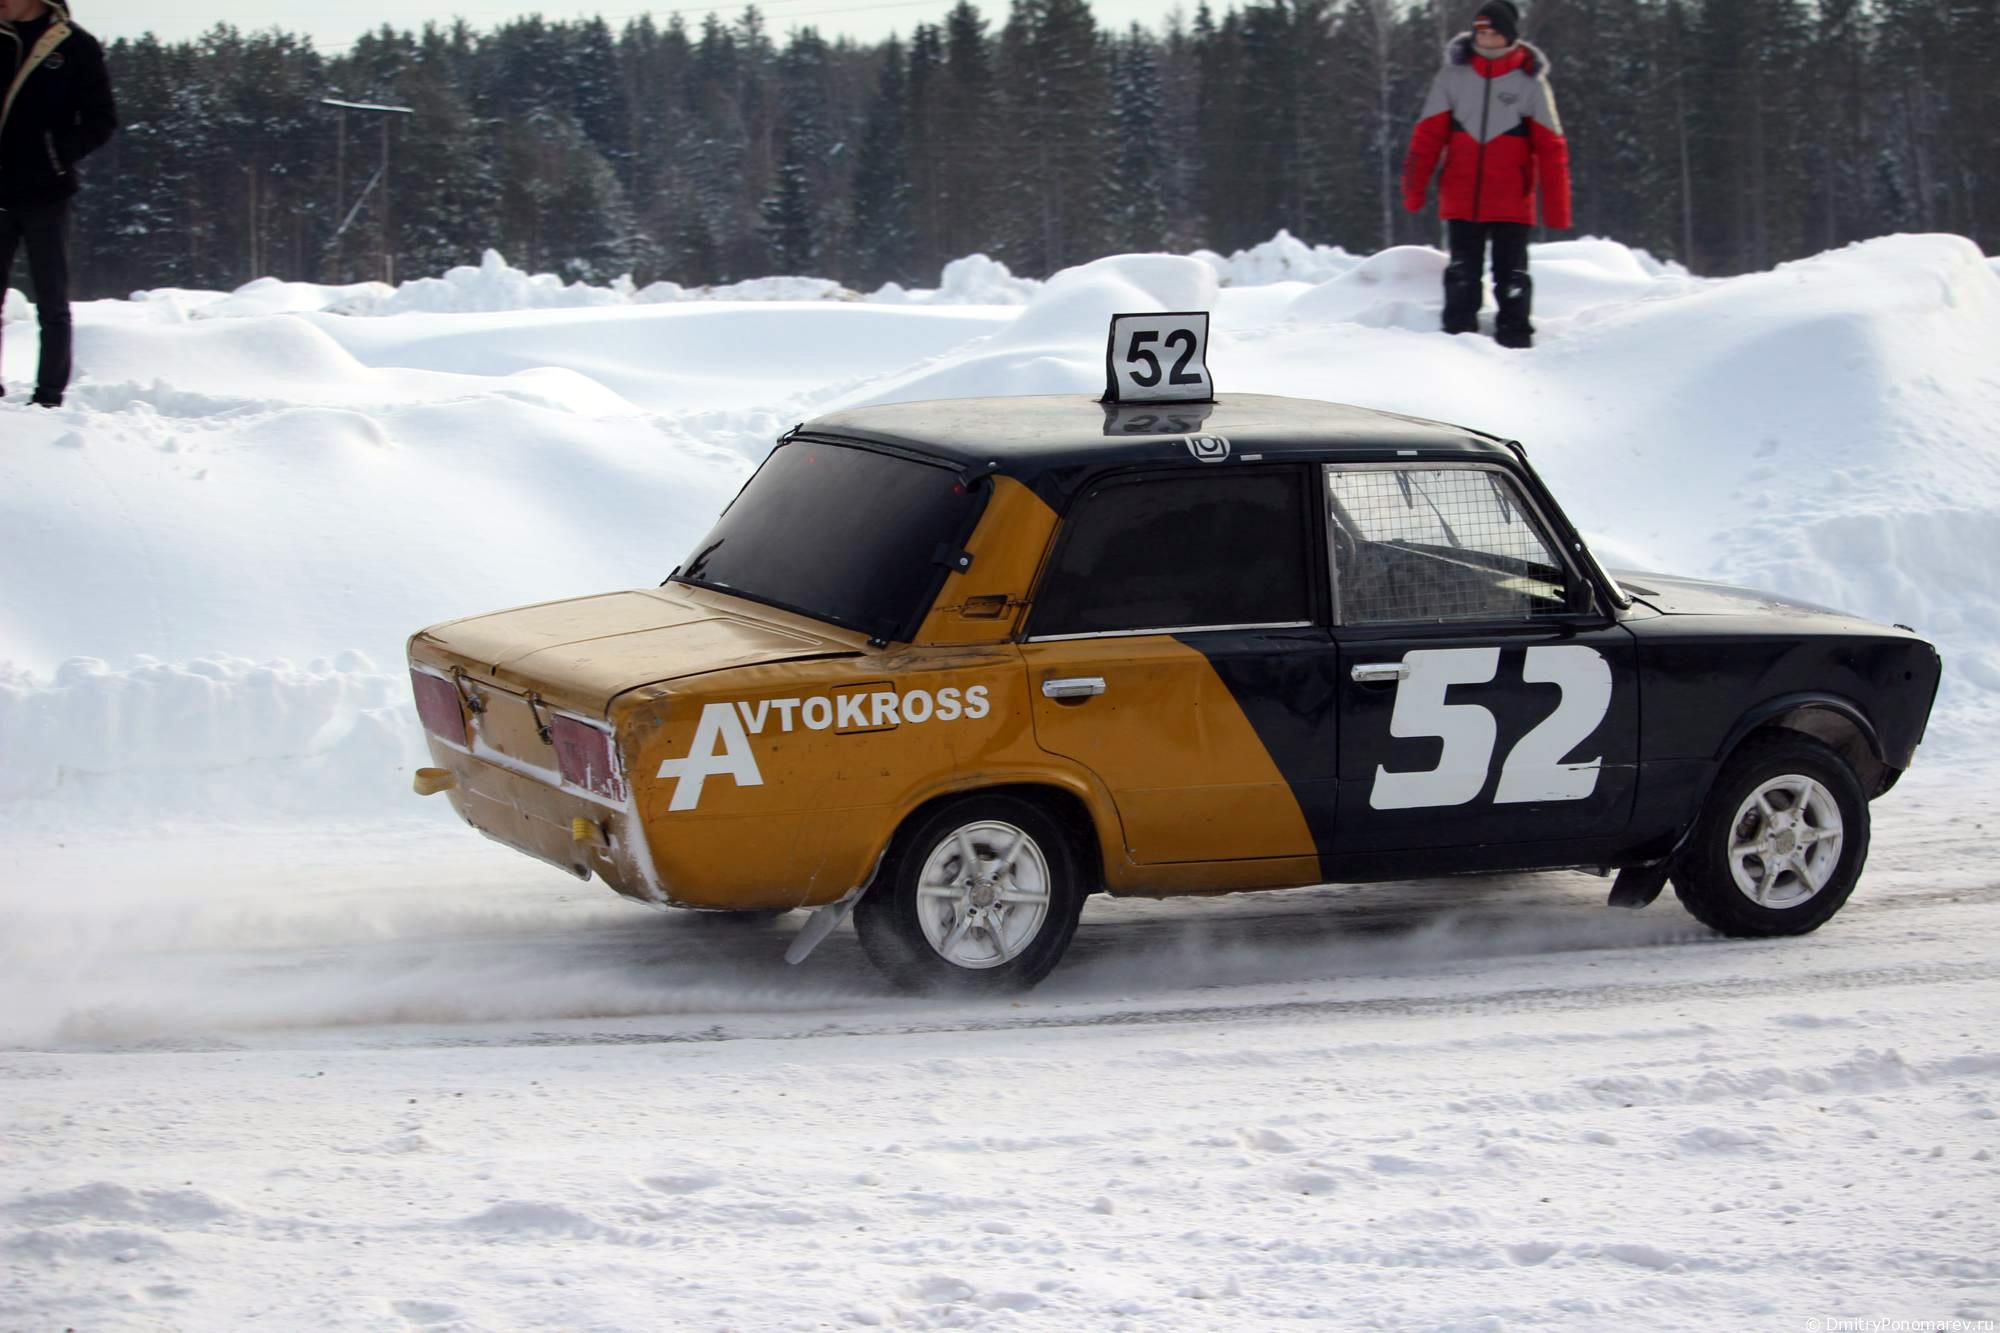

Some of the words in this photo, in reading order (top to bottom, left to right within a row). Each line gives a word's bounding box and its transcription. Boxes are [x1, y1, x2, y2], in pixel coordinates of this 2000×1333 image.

[1127, 329, 1202, 387] 52
[656, 685, 990, 811] AVTOKROSS
[1369, 645, 1613, 810] 52
